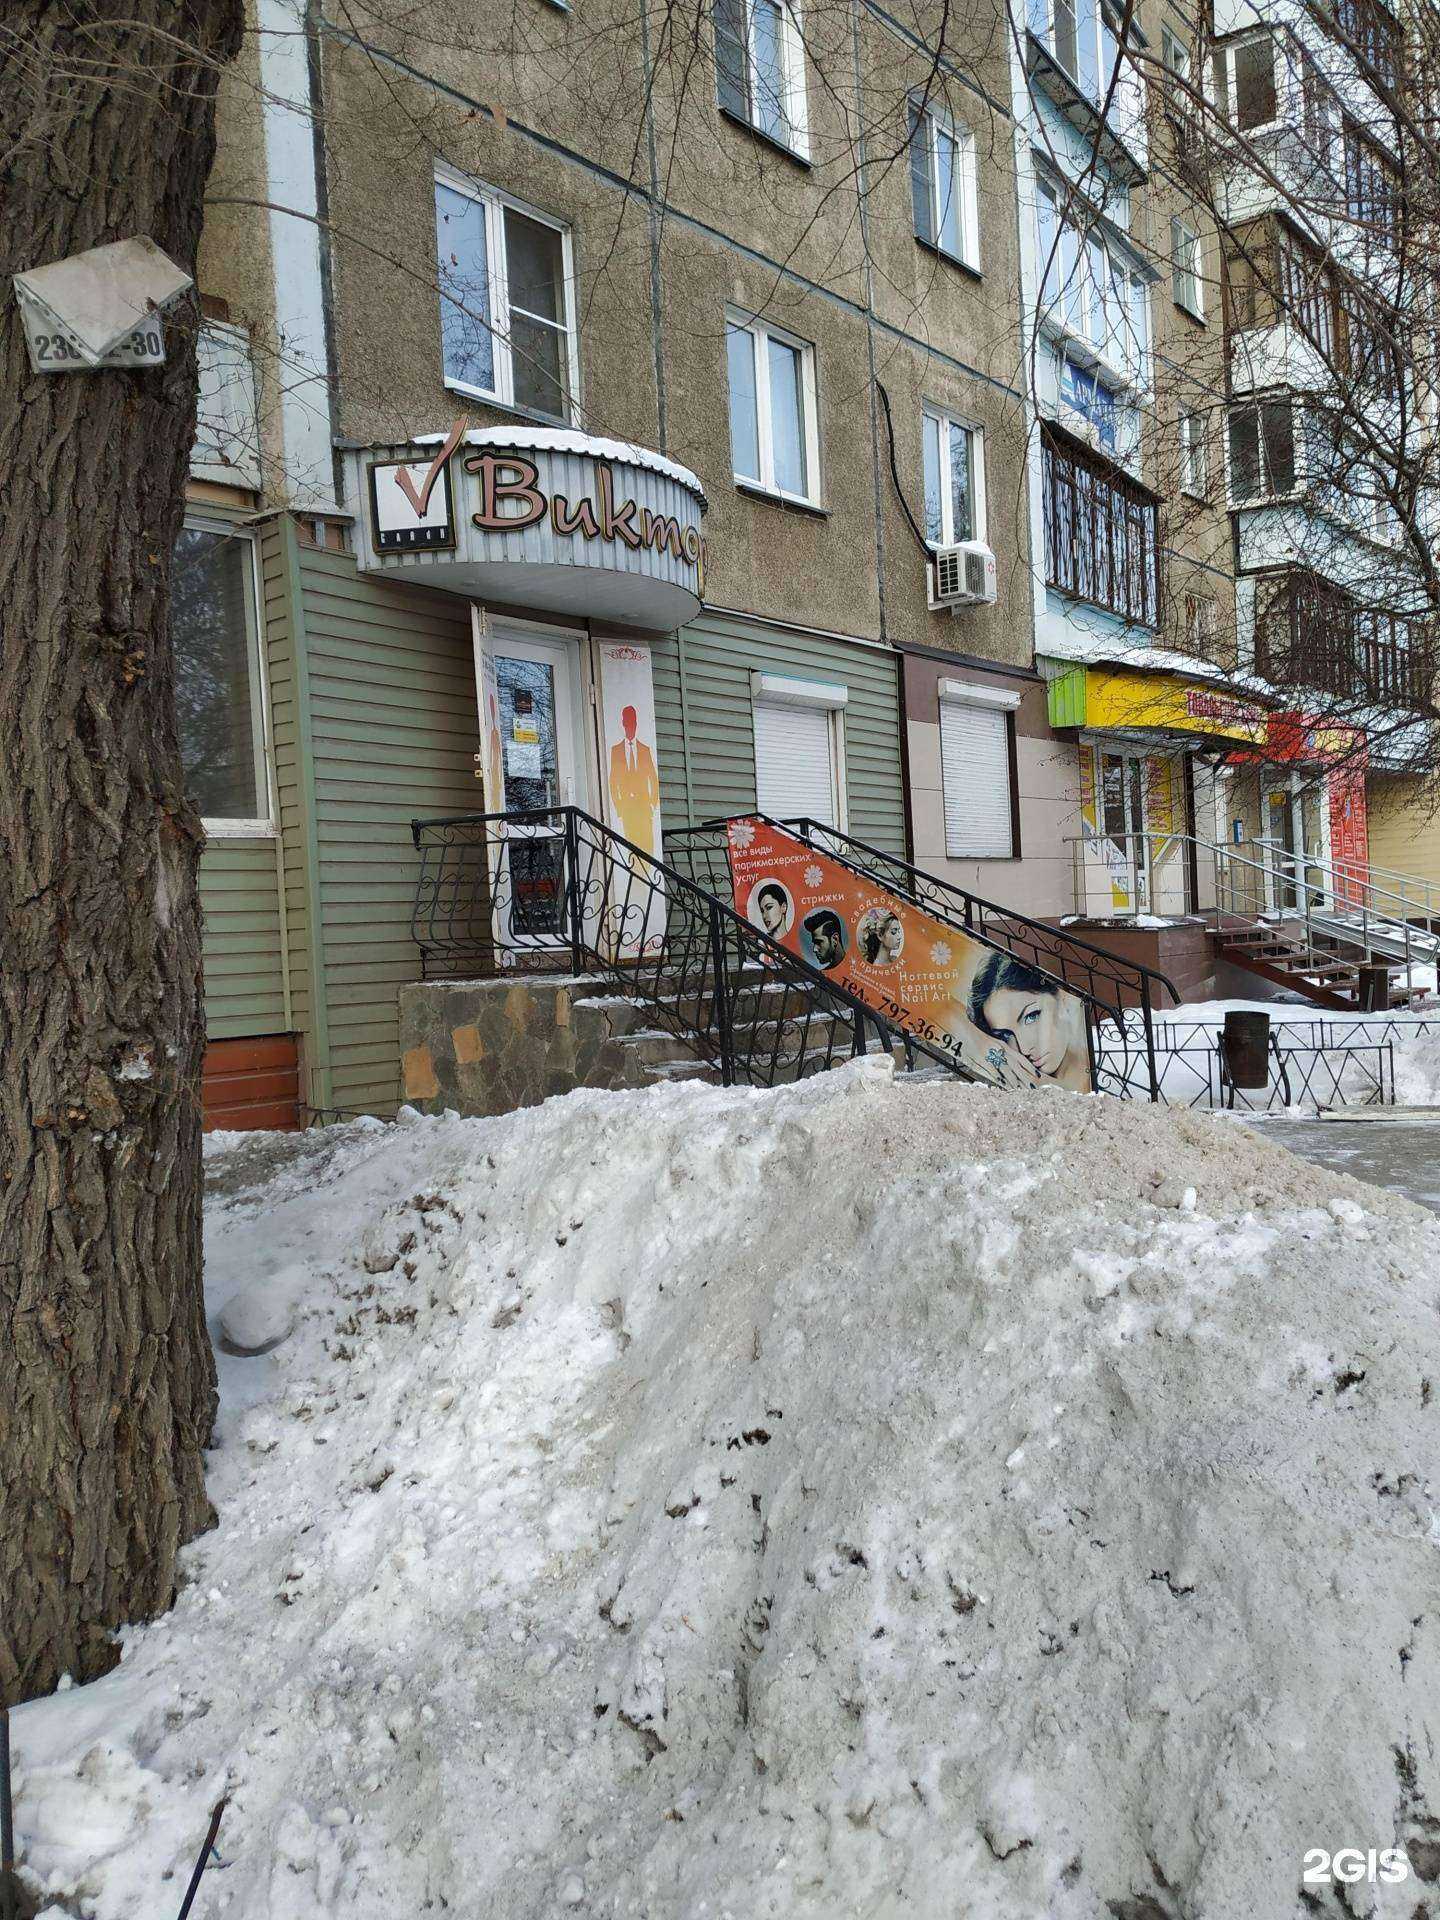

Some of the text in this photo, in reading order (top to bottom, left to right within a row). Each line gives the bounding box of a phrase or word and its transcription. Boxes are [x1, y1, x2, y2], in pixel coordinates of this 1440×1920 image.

[733, 846, 773, 858] все виды
[735, 872, 760, 886] услуг
[801, 892, 845, 907] стрижки
[898, 968, 960, 982] Ногтевой
[900, 982, 945, 995] сервис
[901, 991, 951, 1003] Nail Art
[877, 996, 963, 1058] 797-36-94
